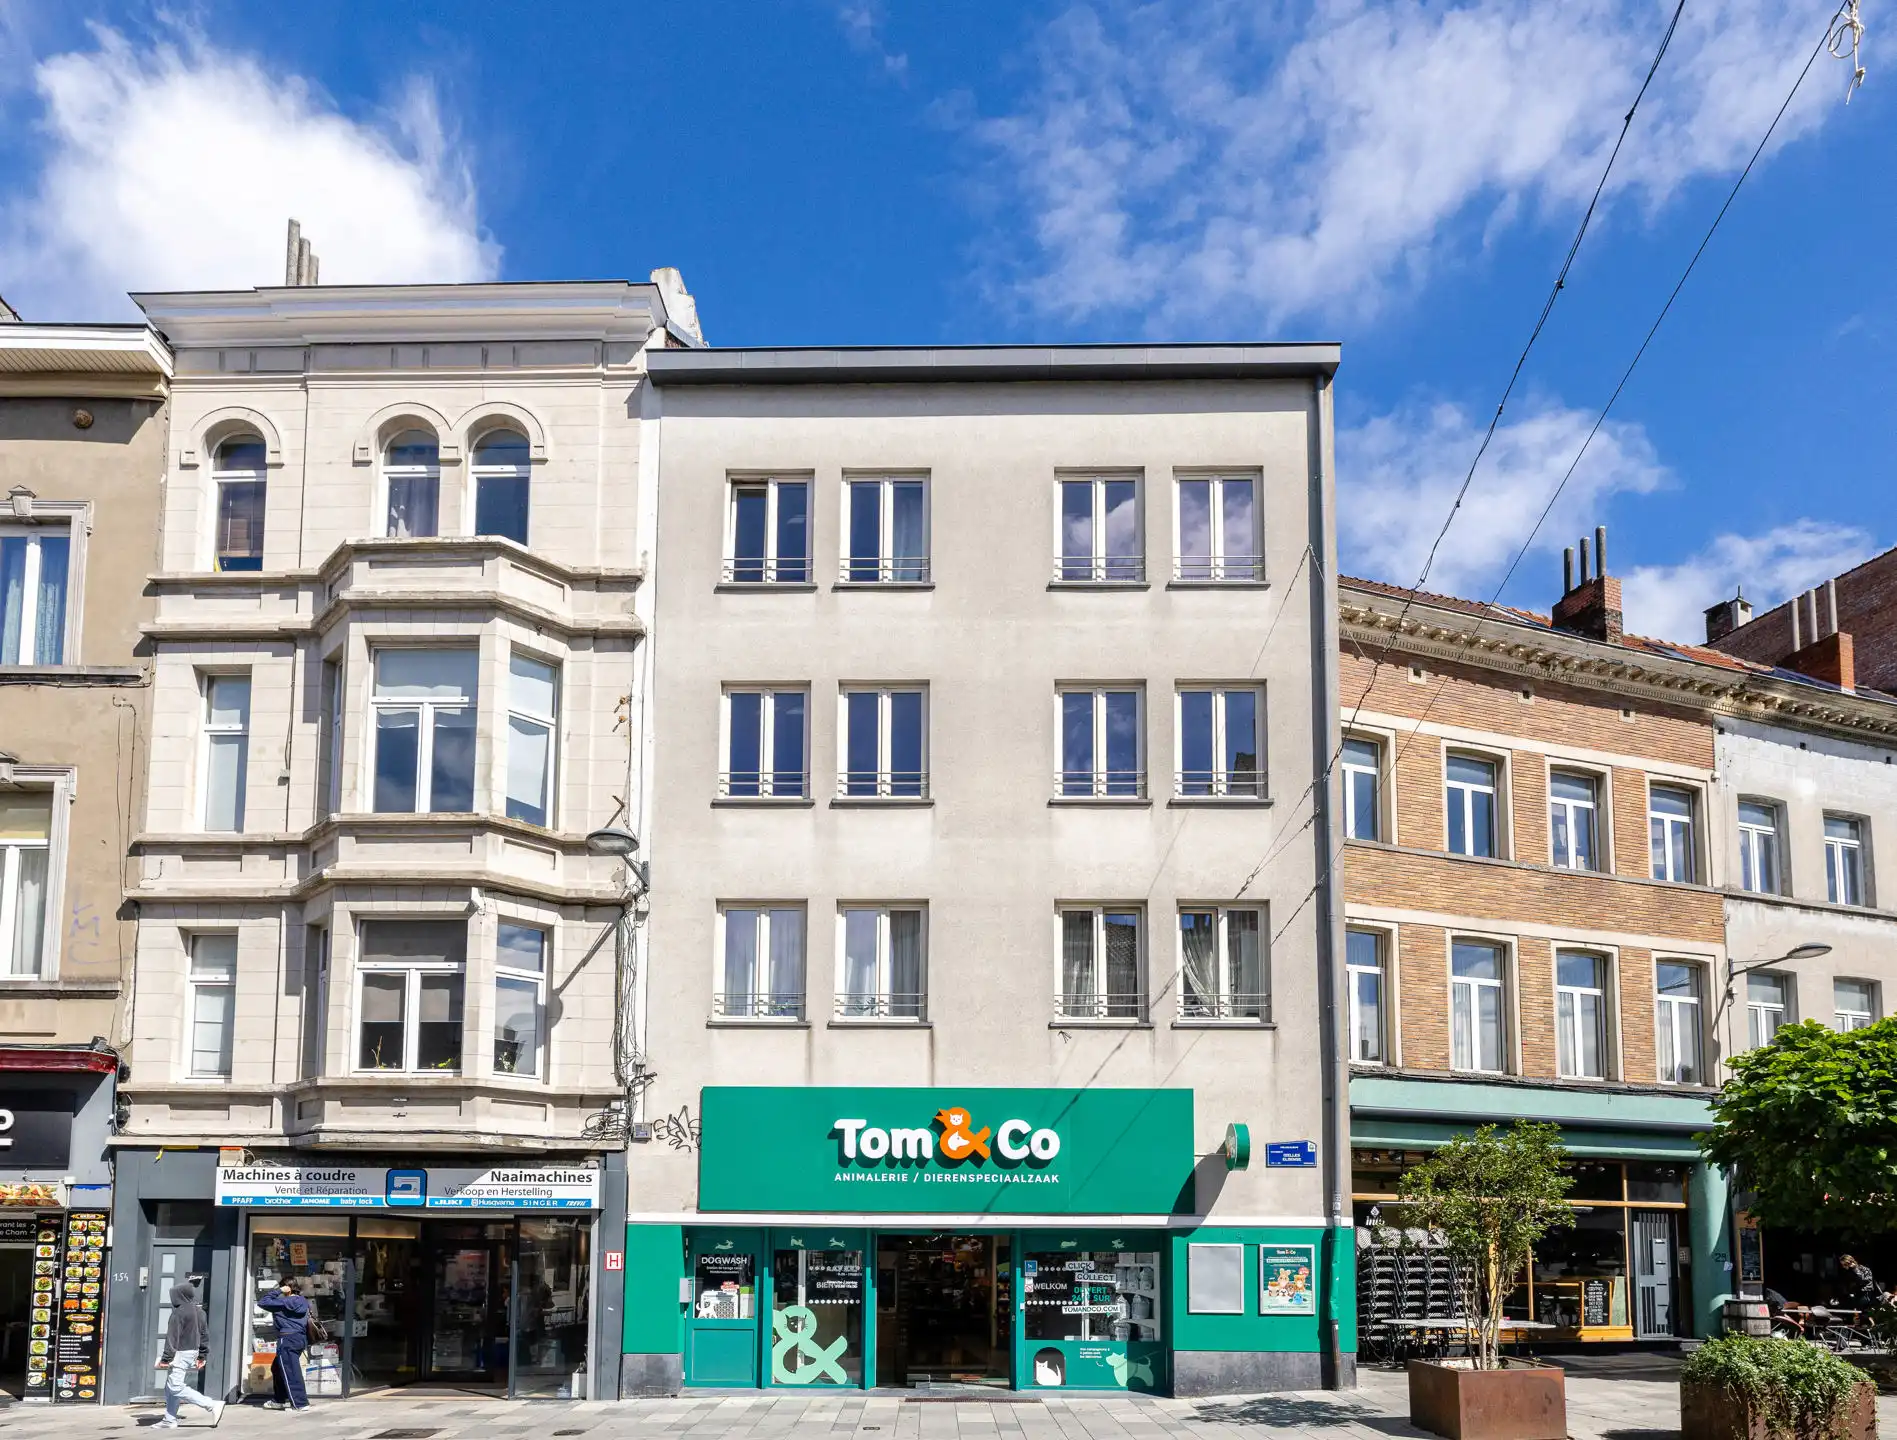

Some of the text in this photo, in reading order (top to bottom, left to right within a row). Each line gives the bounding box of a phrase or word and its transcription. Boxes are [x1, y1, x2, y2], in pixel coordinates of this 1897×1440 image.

[834, 1119, 933, 1159] Tom
[997, 1119, 1060, 1160] Co
[223, 1169, 356, 1181] Machines à coudre
[491, 1171, 592, 1183] Naaimachines
[834, 1173, 908, 1182] ANIMALERIE
[924, 1173, 1060, 1183] DIERENSPECIAALZAAK
[275, 1185, 368, 1196] Vente et Réparation
[444, 1187, 485, 1197] Verkoop
[501, 1187, 553, 1198] Herstelling
[264, 1197, 292, 1205] brother
[340, 1198, 356, 1206] baby
[478, 1198, 515, 1206] Husqvarna
[609, 1254, 619, 1267] H
[701, 1256, 748, 1265] DOGWASH
[1076, 1273, 1114, 1281] COLLECT
[1093, 1294, 1111, 1302] SUR
